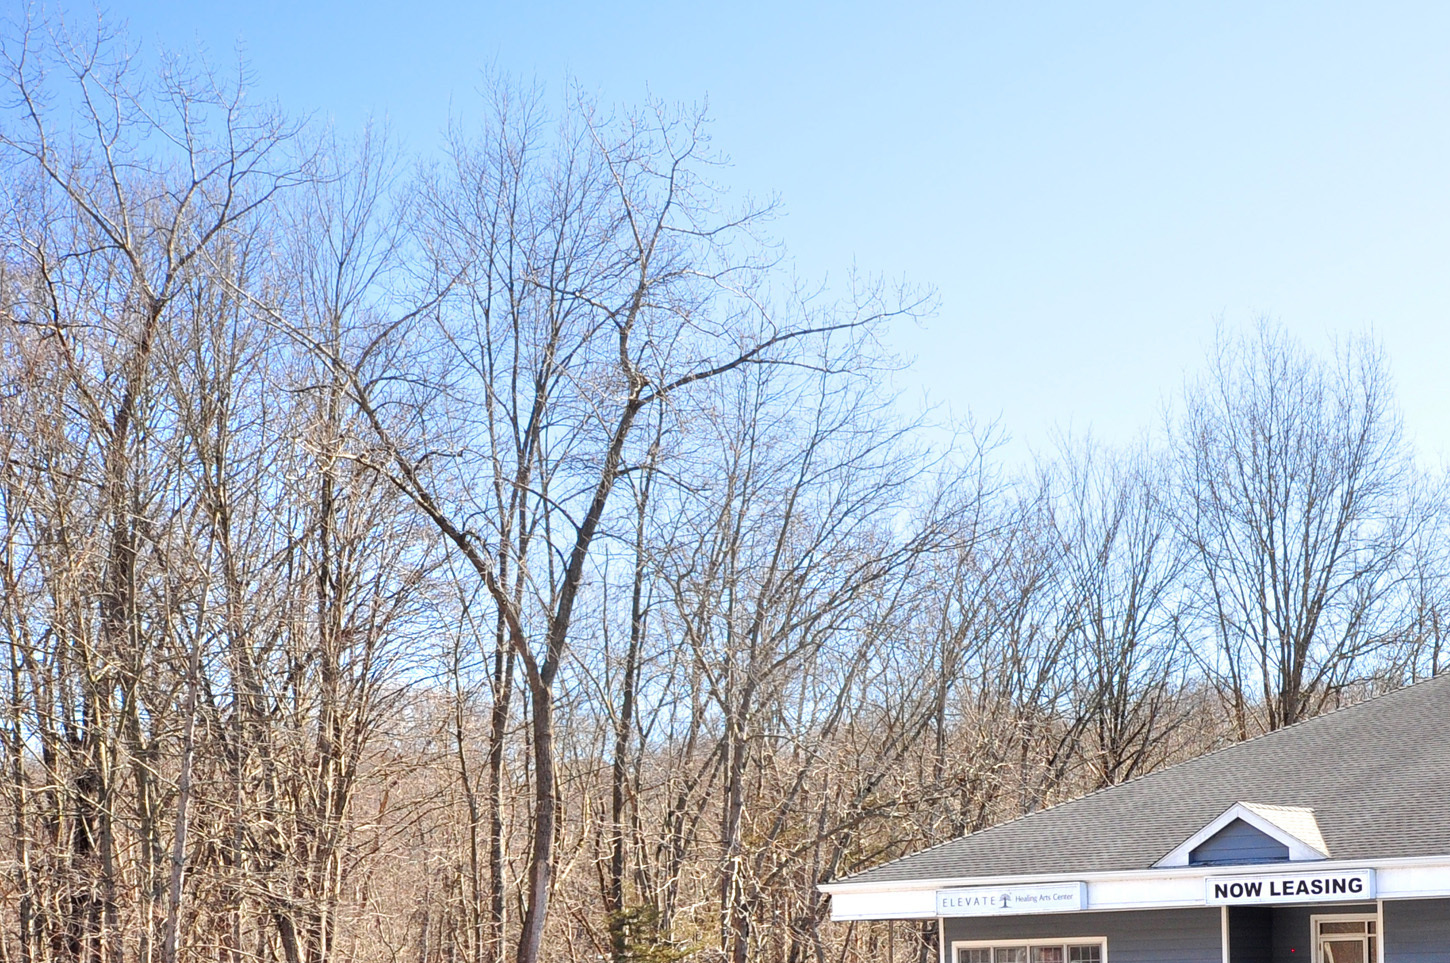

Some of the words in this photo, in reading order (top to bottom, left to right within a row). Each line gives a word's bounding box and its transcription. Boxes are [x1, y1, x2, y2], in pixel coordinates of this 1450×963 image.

[1214, 882, 1262, 899] NOW
[1270, 877, 1363, 897] LEASING
[942, 896, 996, 908] ELEVATE
[1015, 894, 1038, 904] Healing
[1039, 893, 1051, 901] Arts
[1053, 892, 1073, 901] Center
